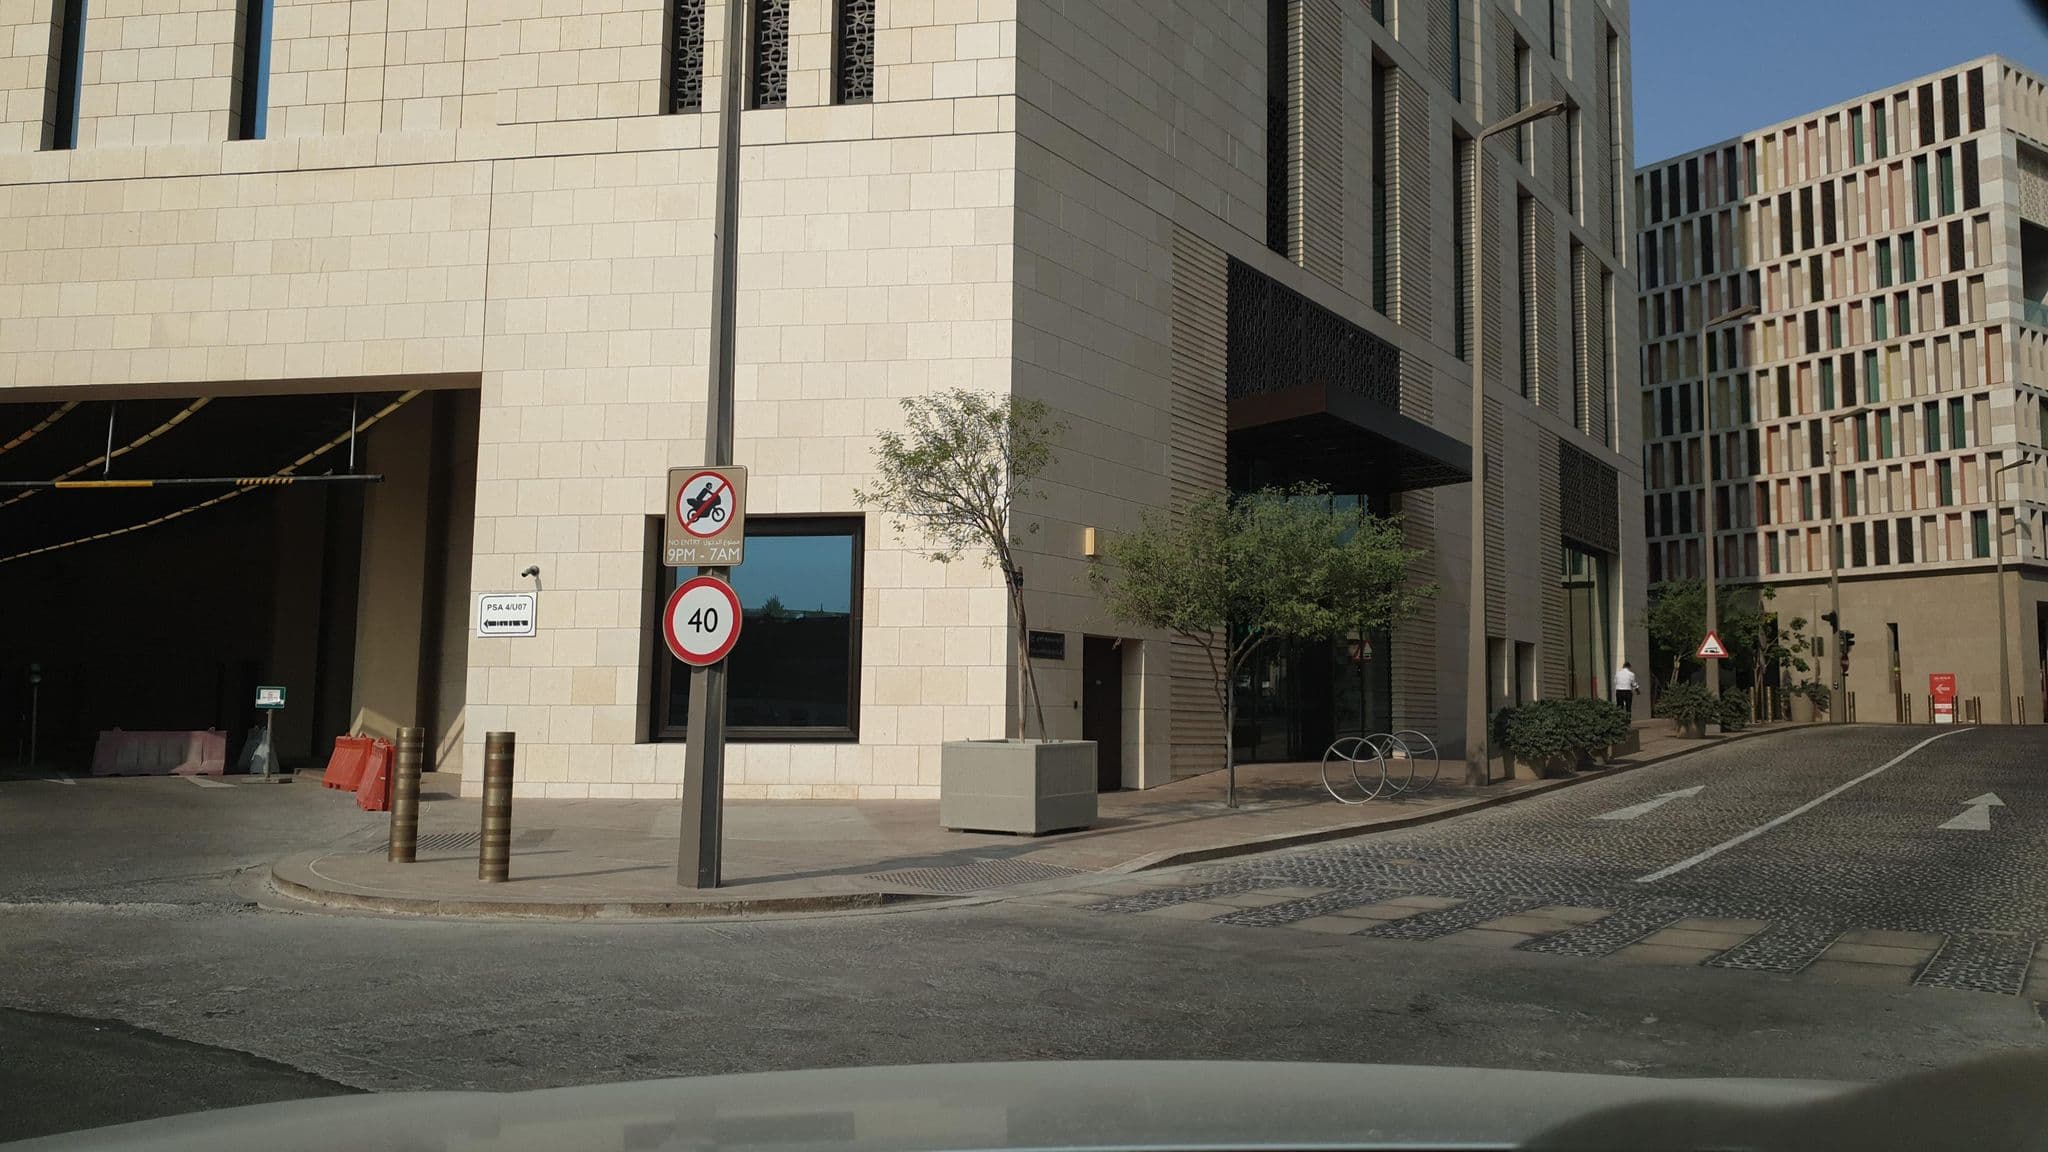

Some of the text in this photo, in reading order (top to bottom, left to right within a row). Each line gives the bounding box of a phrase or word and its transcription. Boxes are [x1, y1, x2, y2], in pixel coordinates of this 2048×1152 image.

[668, 548, 696, 561] 9PM
[709, 547, 740, 561] 7AM
[487, 603, 527, 611] PSA 4/U07
[687, 607, 718, 633] 40
